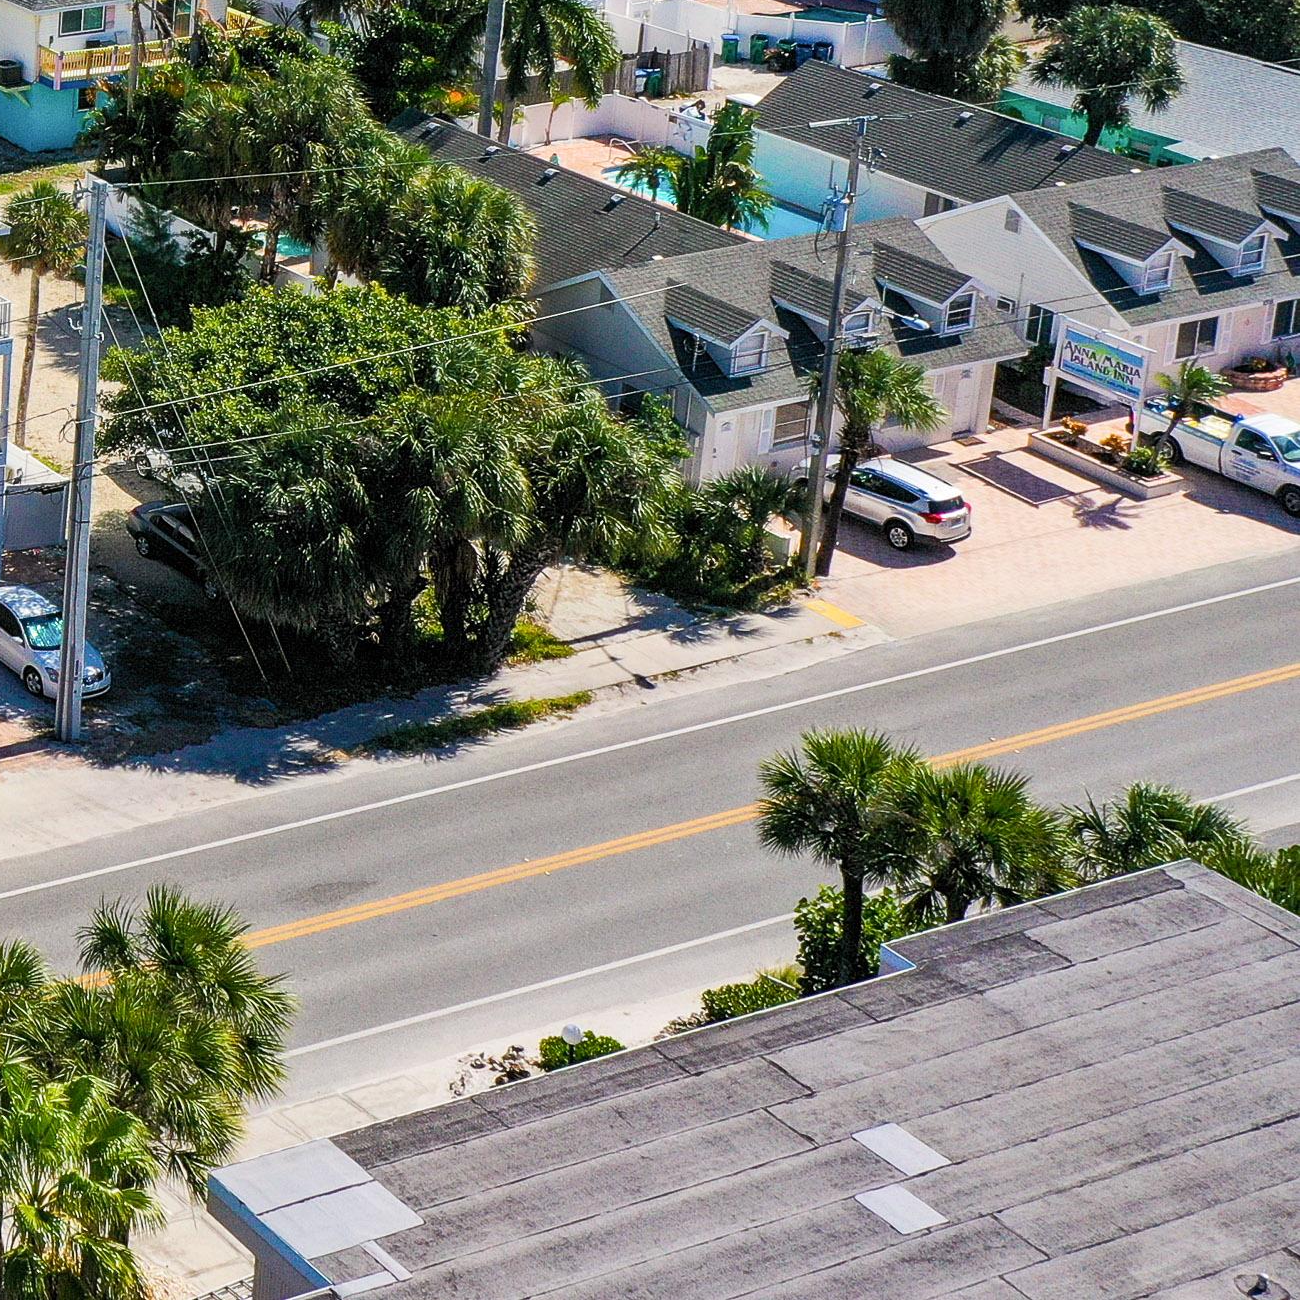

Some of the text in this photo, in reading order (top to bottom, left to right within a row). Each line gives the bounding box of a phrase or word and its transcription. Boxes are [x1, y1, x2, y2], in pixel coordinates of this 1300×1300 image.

[1064, 341, 1097, 361] ANNA
[1103, 355, 1141, 378] MARIA
[1070, 351, 1110, 375] ISLAND
[1113, 369, 1134, 385] INN
